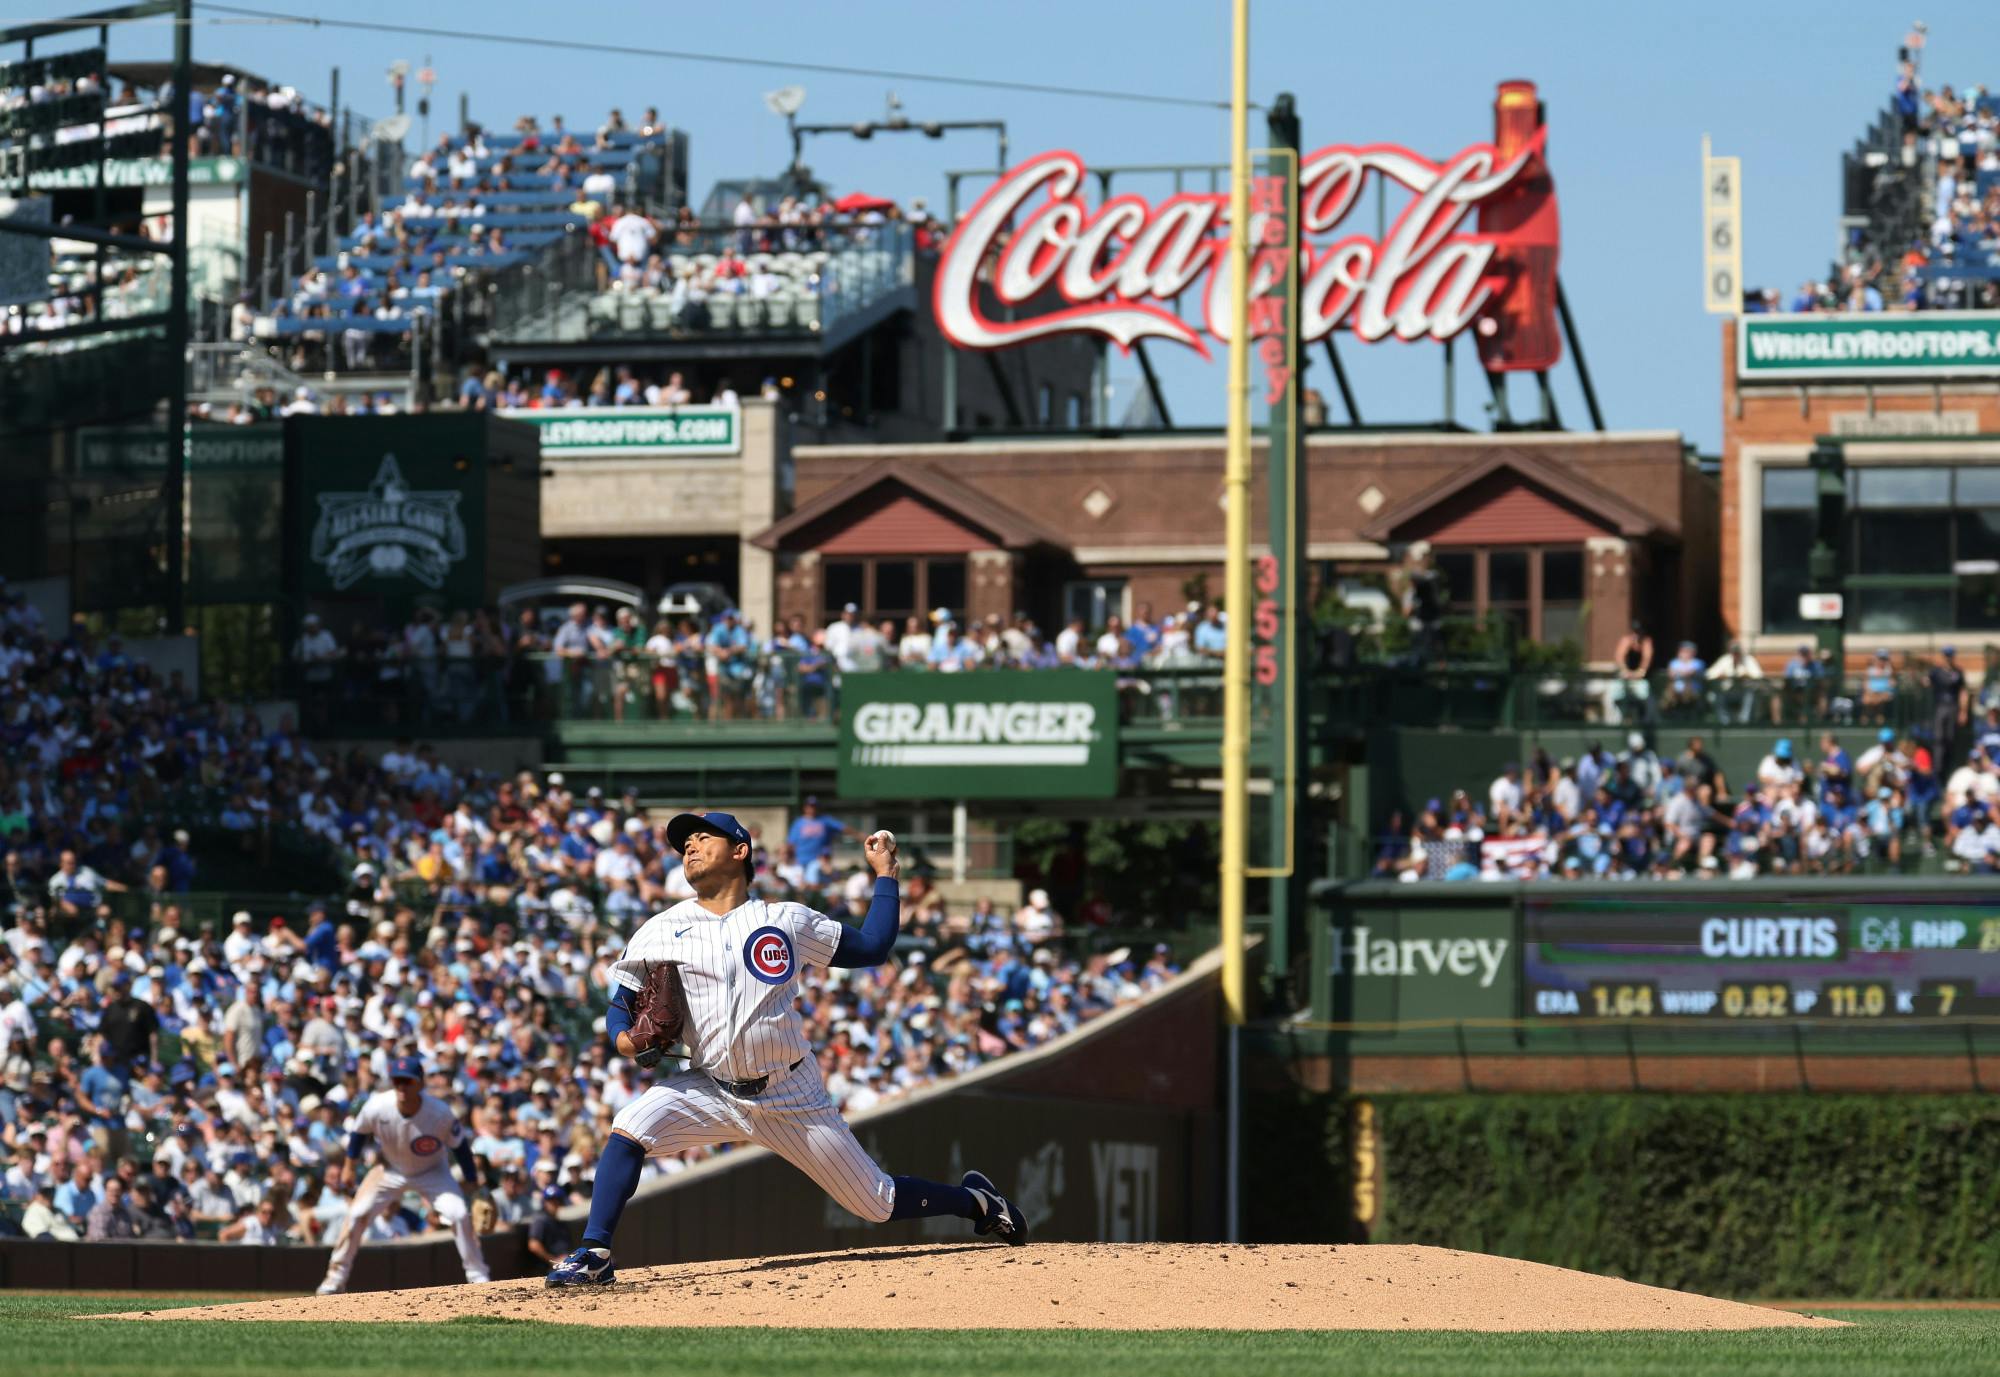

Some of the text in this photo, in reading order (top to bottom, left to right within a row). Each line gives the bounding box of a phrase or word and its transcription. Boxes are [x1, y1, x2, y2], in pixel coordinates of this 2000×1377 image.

[1752, 330, 2000, 359] WRIGLEYROOFTOPS.
[1256, 555, 1279, 687] 355
[853, 702, 1096, 743] GRAINGER
[754, 936, 788, 974] CUBS
[1330, 926, 1509, 988] Harvey
[1702, 917, 1838, 957] CURTIS
[1911, 921, 1967, 948] RHP
[1536, 985, 1956, 1016] ERA 1.64 WHIP 0.82 IP 11.0 K 7
[1090, 1140, 1158, 1242] YETI
